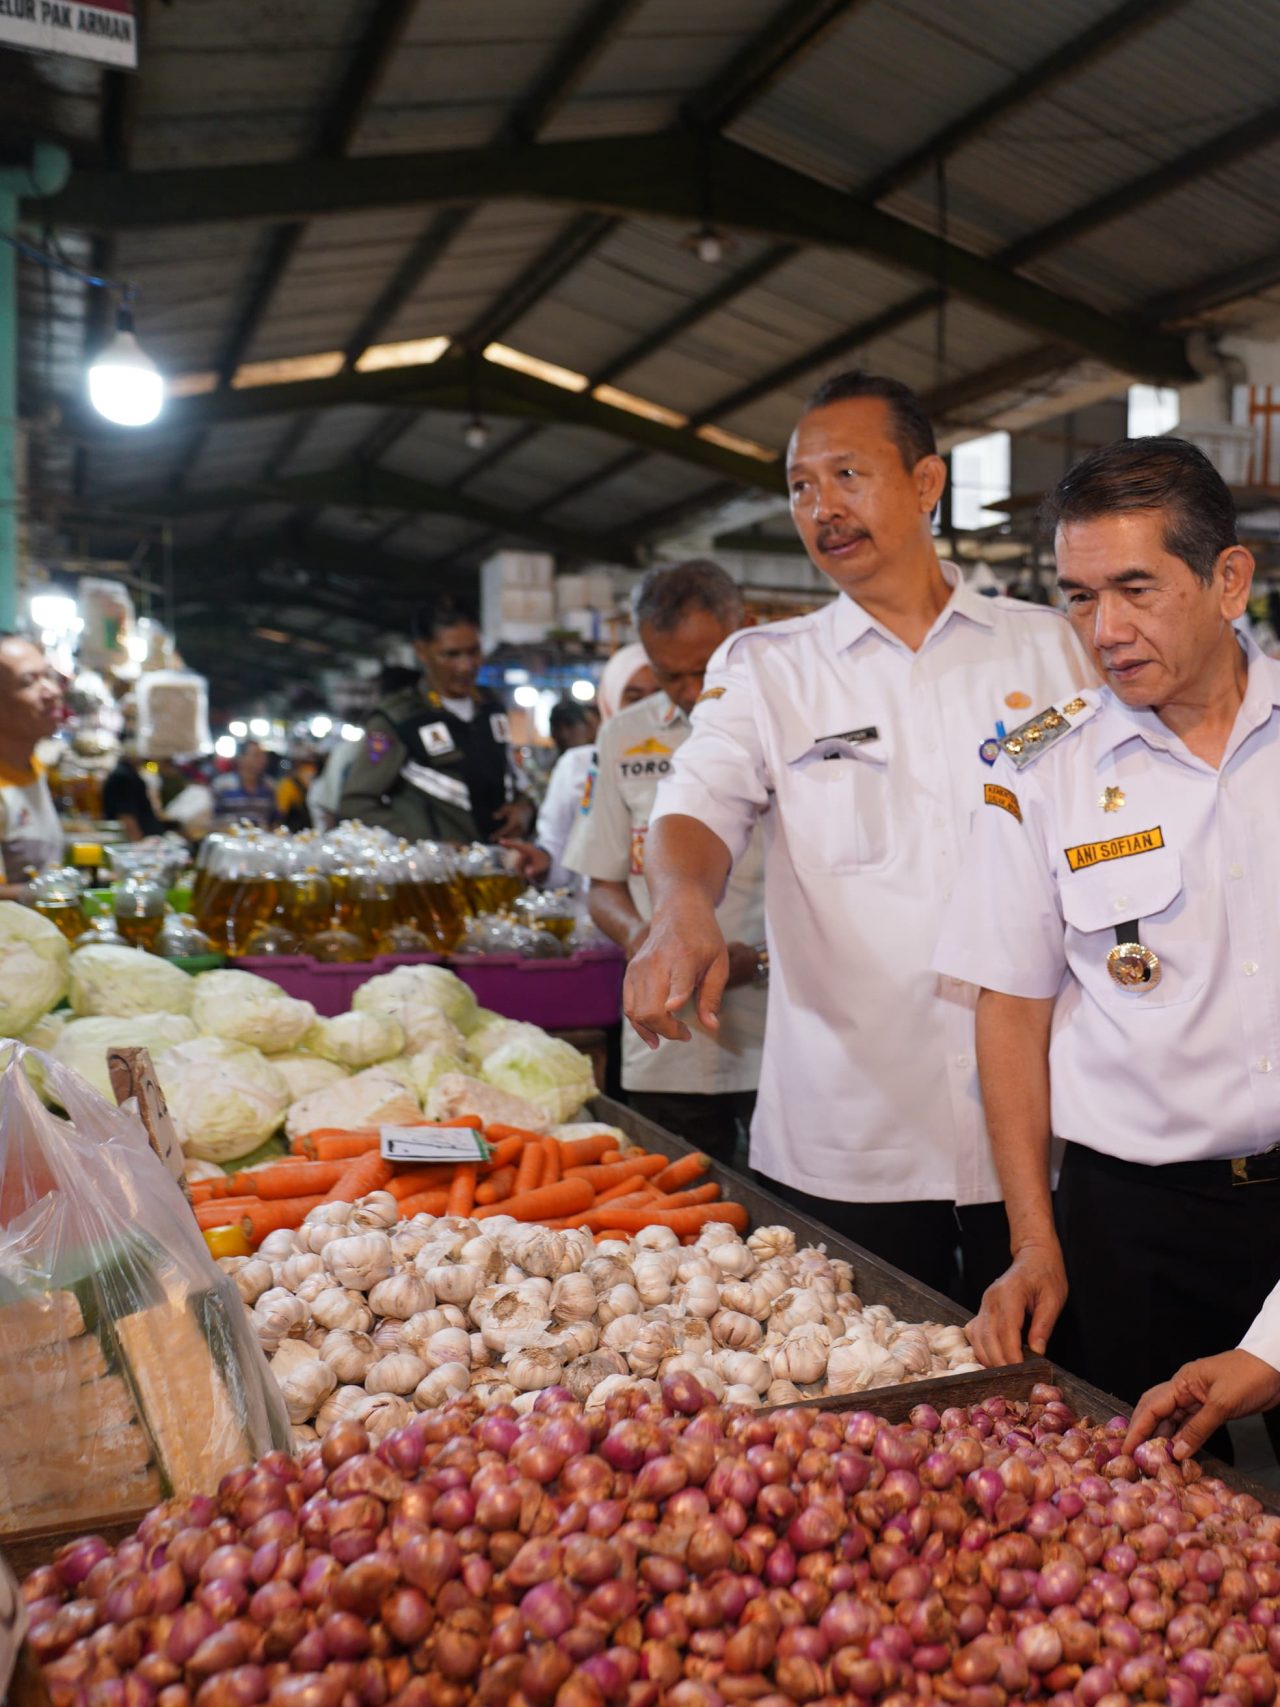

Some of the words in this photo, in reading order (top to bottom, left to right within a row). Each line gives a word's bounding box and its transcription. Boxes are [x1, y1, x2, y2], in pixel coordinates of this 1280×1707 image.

[41, 1, 72, 30] PAK
[77, 9, 131, 42] ARMAN
[620, 760, 671, 777] TORO
[1076, 846, 1098, 866] ANI
[1100, 833, 1153, 858] SOFIAN
